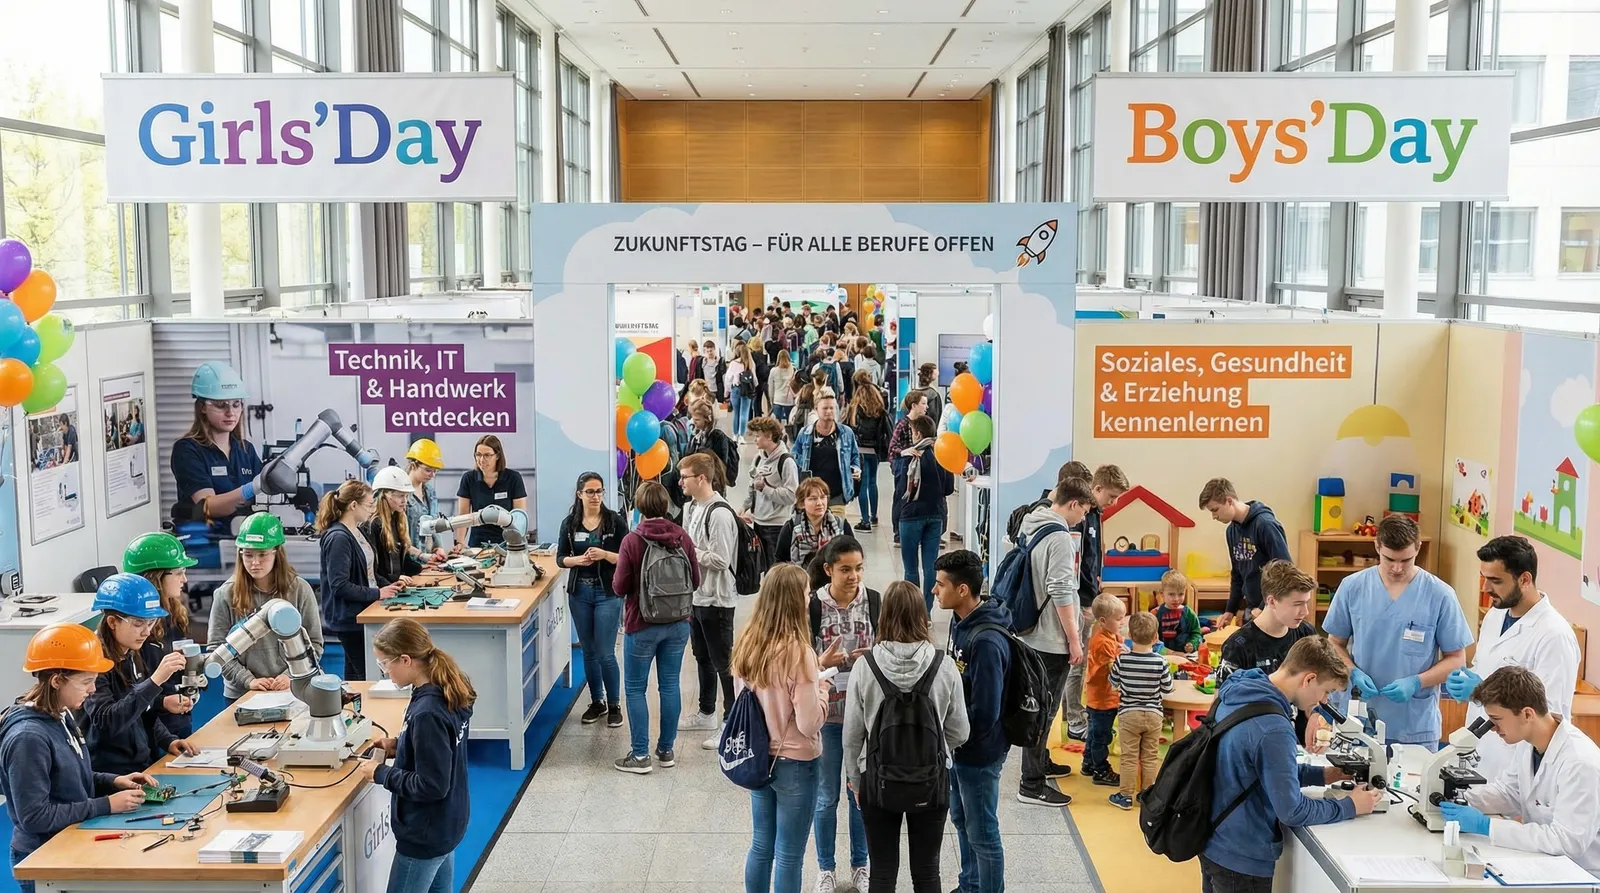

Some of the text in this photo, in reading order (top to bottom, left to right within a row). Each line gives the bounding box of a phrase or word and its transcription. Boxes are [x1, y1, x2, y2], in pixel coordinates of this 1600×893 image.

[138, 100, 482, 183] Girls’Day
[1126, 99, 1478, 183] Boys’Day
[613, 236, 747, 252] ZUKUNFTSTAG
[767, 232, 804, 252] FÜR
[807, 236, 853, 252] ALLE
[857, 236, 929, 252] BERUFE
[934, 236, 994, 252] OFFEN
[335, 350, 458, 374] Technik, IT
[1101, 351, 1347, 377] Soziales, Gesundheit
[366, 377, 506, 399] & Handwerk
[1100, 381, 1242, 407] & Erziehung
[391, 406, 511, 427] entdecken
[1101, 411, 1263, 432] kennenlernen
[364, 804, 390, 860] Girls’
